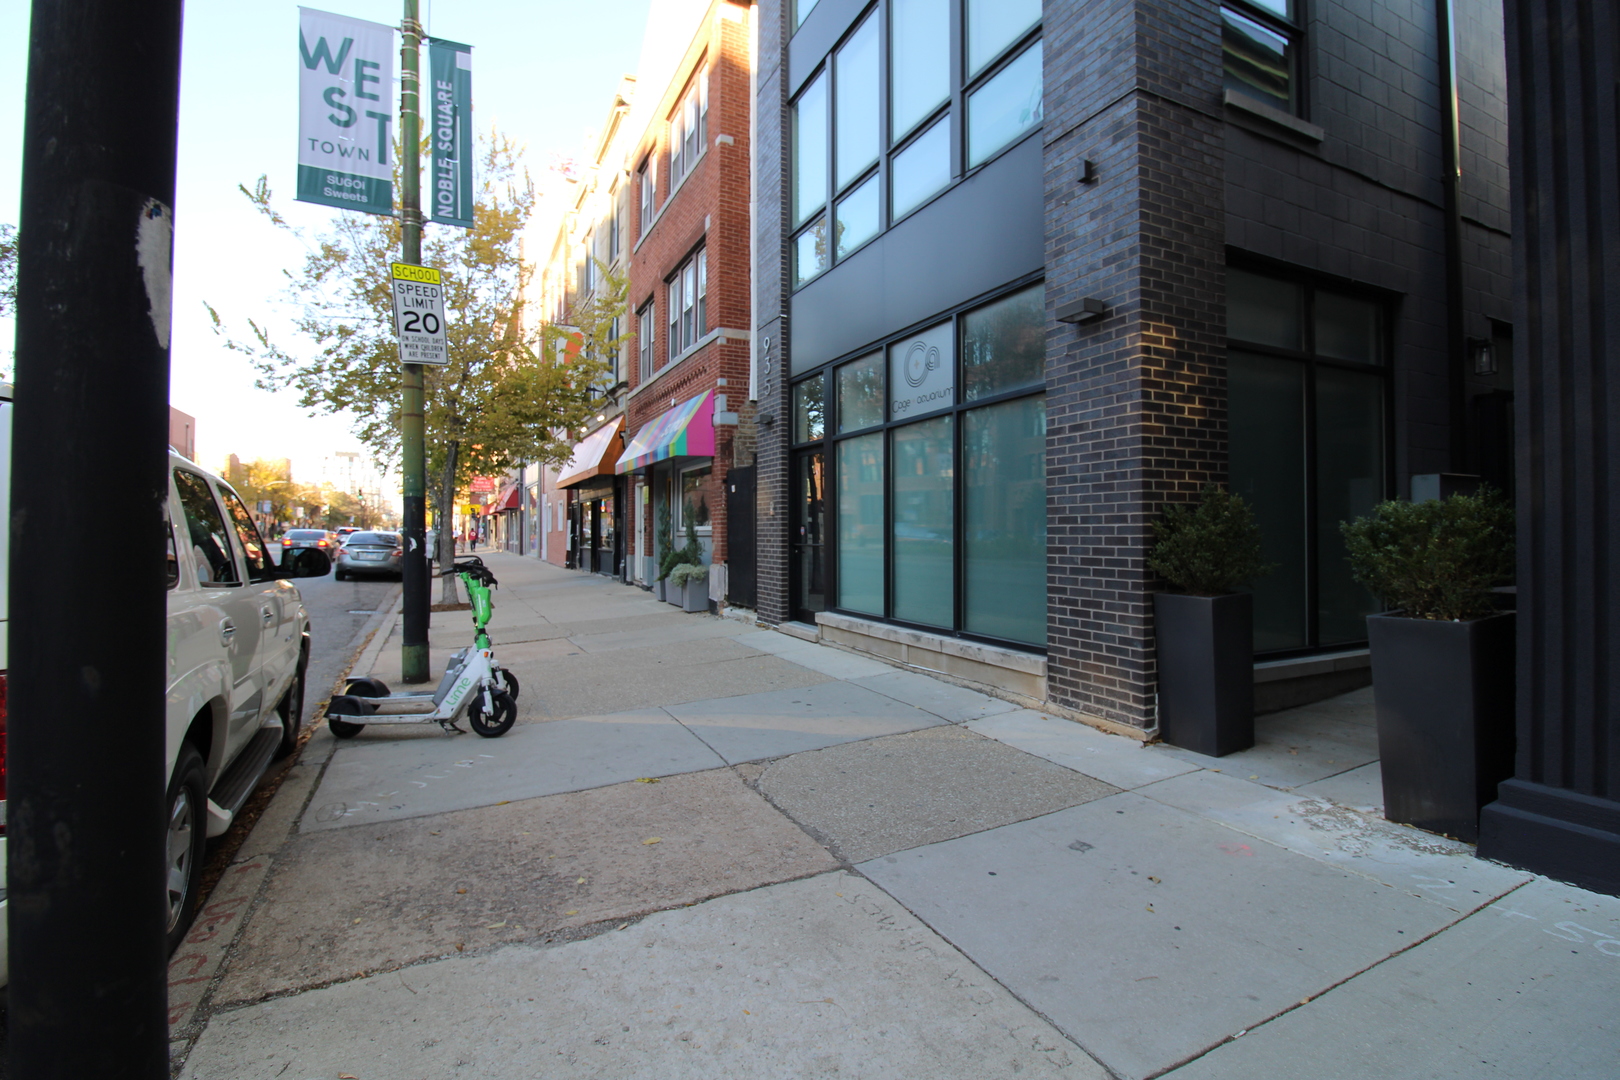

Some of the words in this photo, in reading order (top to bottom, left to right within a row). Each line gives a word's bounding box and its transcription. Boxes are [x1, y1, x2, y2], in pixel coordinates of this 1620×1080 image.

[437, 80, 454, 153] SQUARE
[307, 137, 370, 161] TOWN
[326, 174, 366, 190] SUGOI
[437, 158, 454, 218] NOBLE
[323, 186, 368, 203] Sweets
[394, 265, 438, 282] SCHOOL
[397, 283, 438, 298] SPEED
[403, 296, 435, 310] LIMIT
[402, 310, 440, 335] 20
[404, 342, 419, 350] WHEN
[420, 343, 443, 352] CHILDREN
[411, 335, 430, 344] SCHOOL
[432, 337, 444, 345] DAYS
[408, 350, 419, 358] ARE
[420, 351, 441, 359] PRESENT
[763, 336, 771, 396] 935
[892, 399, 911, 413] Cage
[445, 677, 471, 706] Lime
